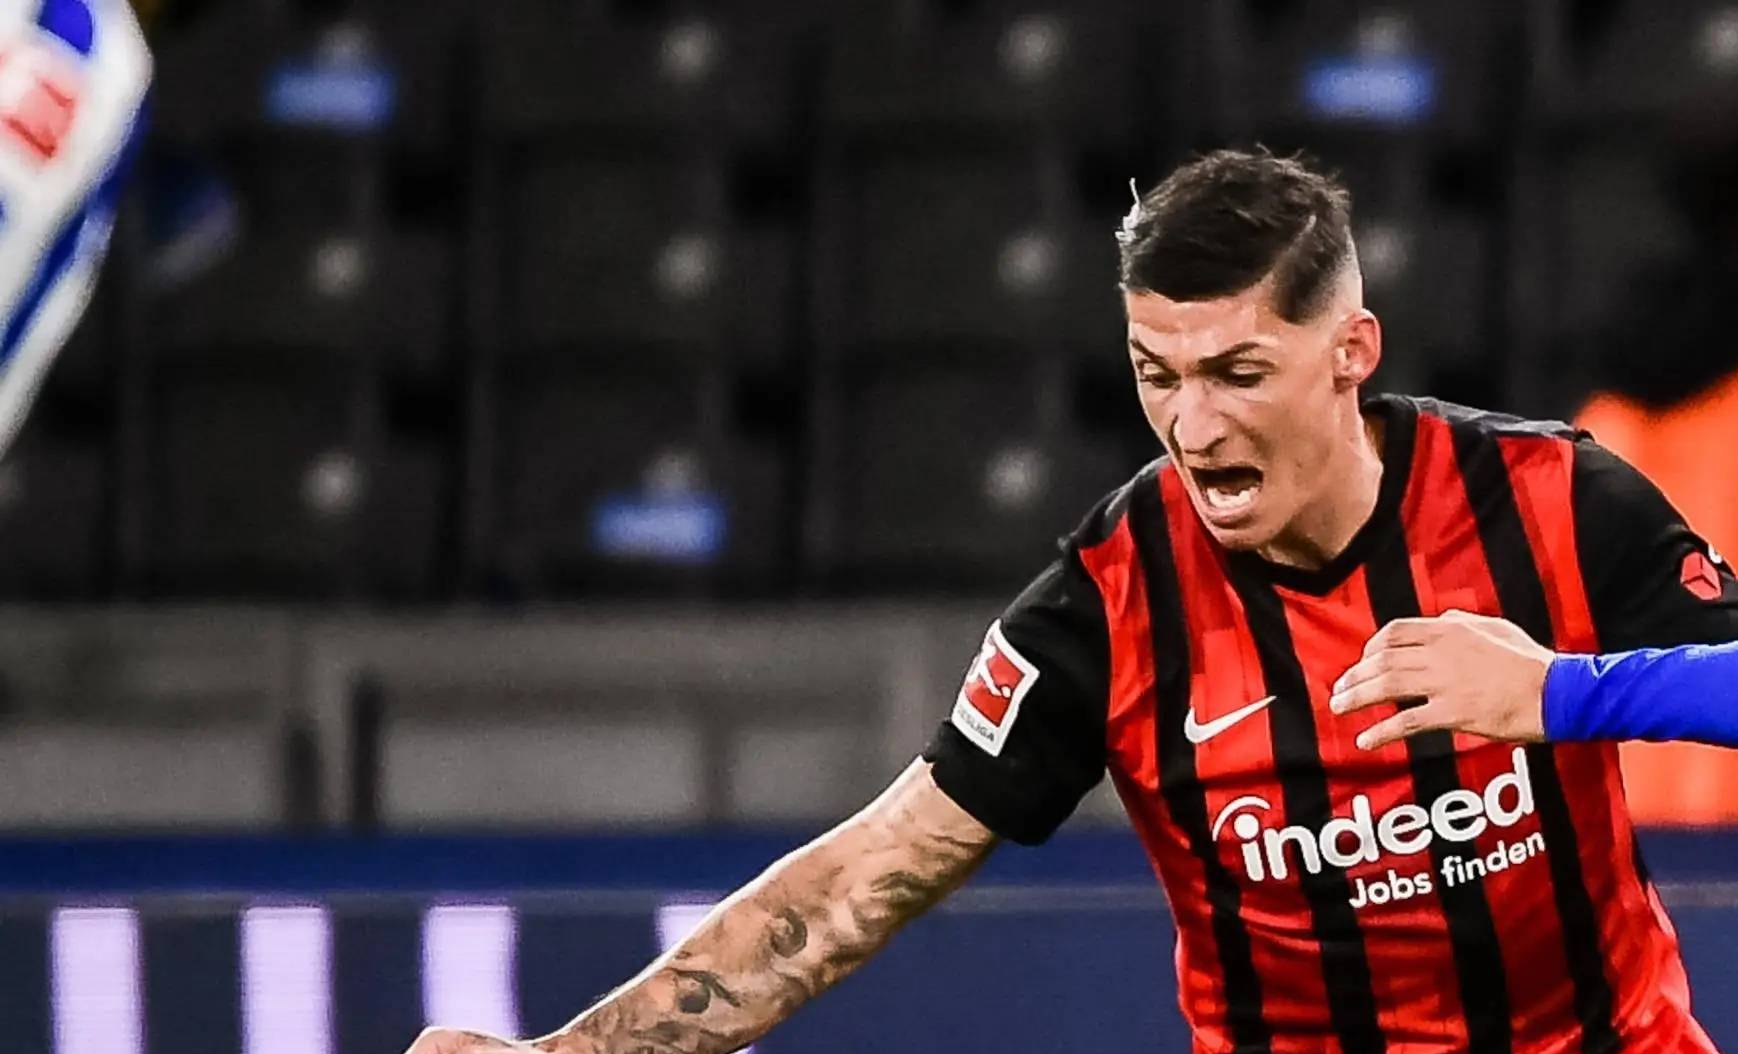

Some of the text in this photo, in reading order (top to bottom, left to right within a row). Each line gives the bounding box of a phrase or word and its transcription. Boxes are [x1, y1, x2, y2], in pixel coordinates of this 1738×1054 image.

[1211, 746, 1535, 882] indeed
[1348, 831, 1546, 909] Jobs finden
